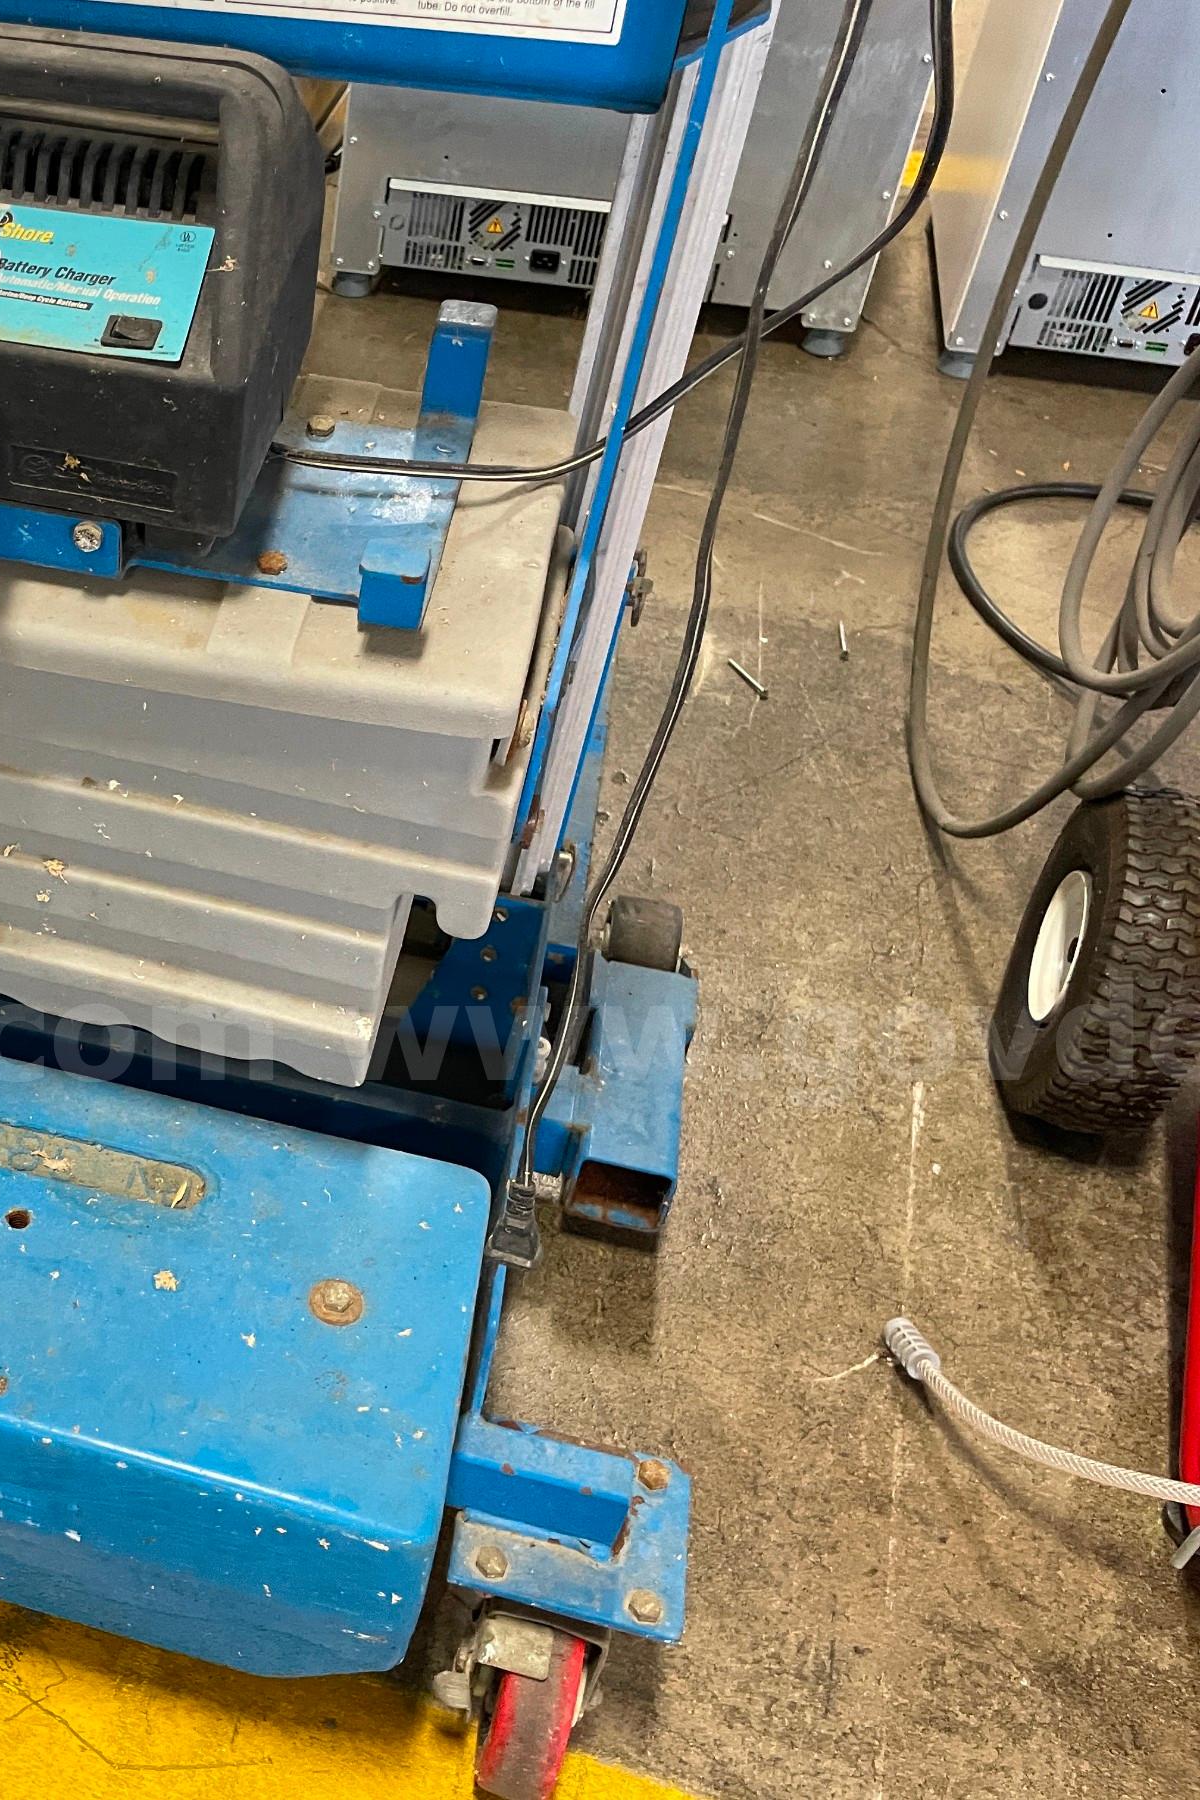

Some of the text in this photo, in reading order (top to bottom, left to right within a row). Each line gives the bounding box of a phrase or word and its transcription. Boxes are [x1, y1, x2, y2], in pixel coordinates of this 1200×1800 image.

[444, 1, 458, 12] Do
[461, 4, 476, 13] not
[54, 266, 117, 286] Charger
[103, 288, 162, 306] Operation
